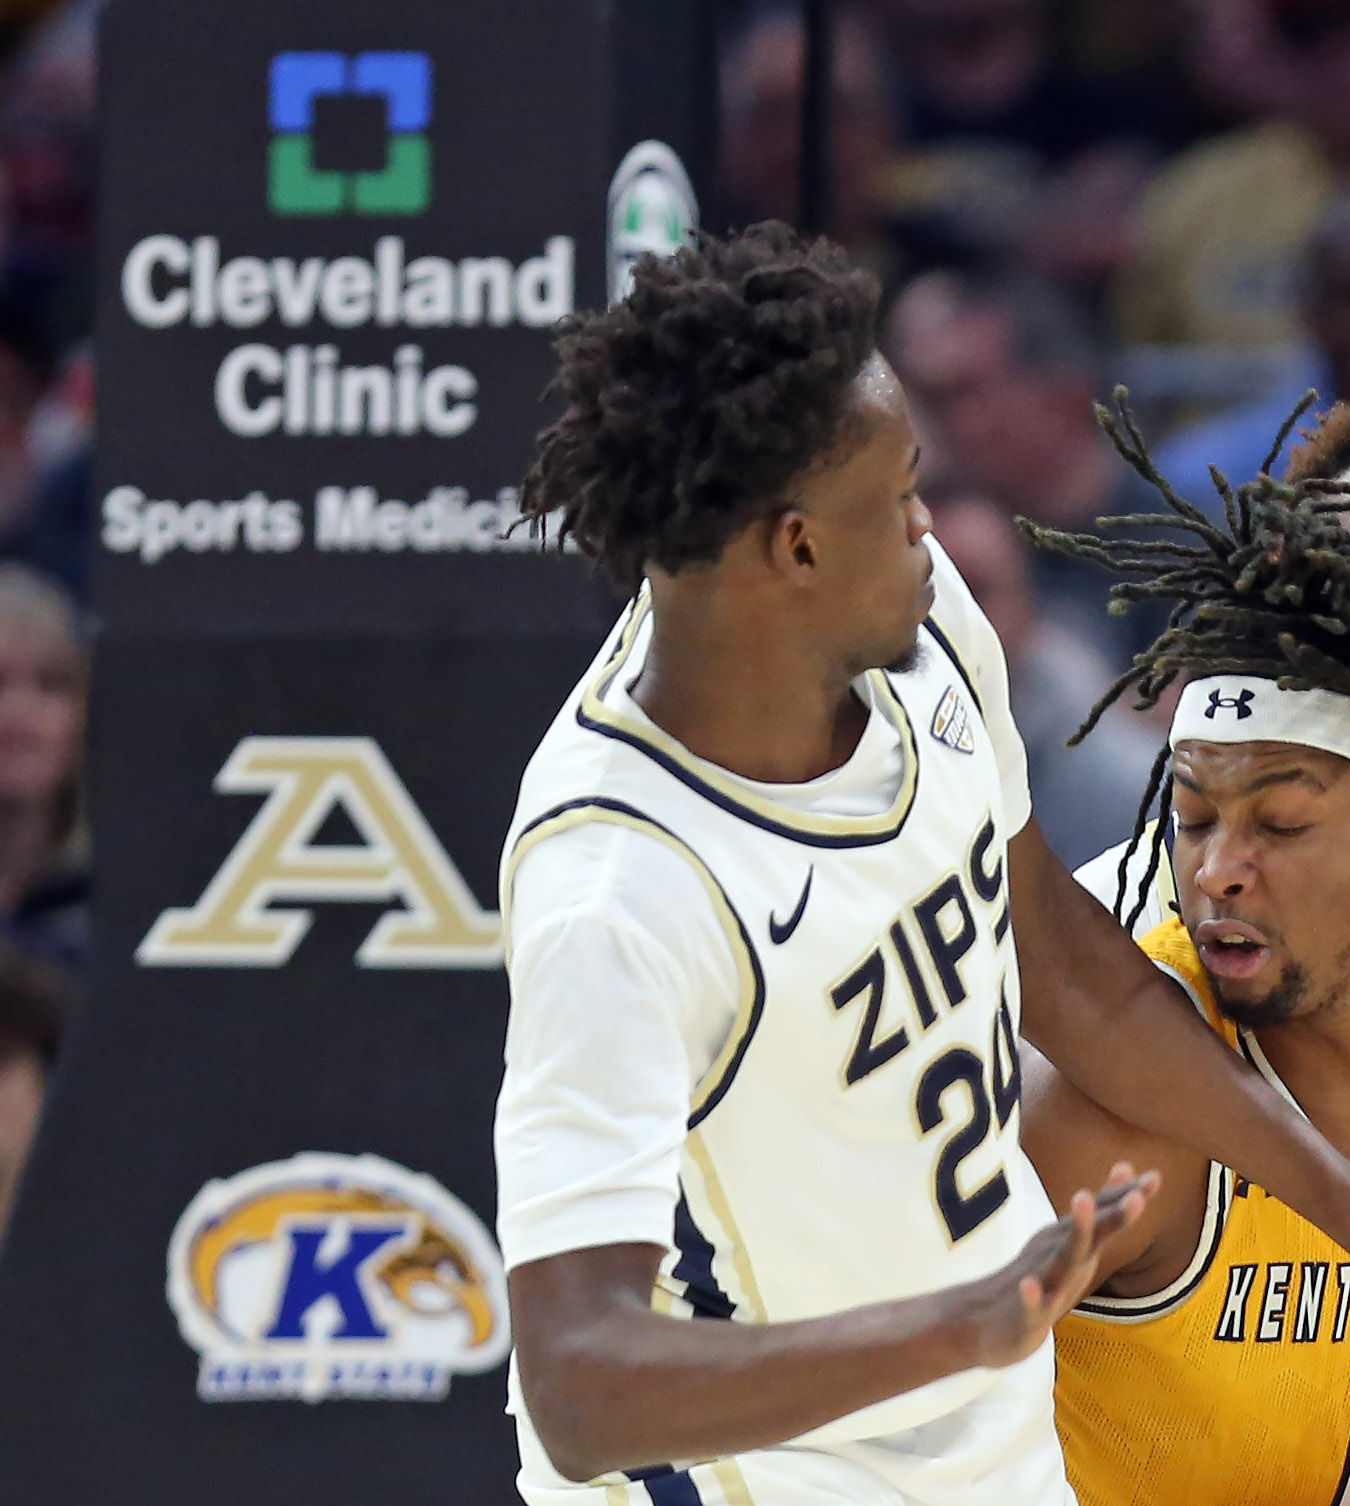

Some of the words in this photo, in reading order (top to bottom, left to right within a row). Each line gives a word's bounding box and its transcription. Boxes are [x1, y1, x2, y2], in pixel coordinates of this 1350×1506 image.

[121, 234, 576, 329] Cleveland
[213, 343, 479, 438] Clinic
[102, 485, 300, 564] Sports
[315, 486, 588, 554] Medicin
[134, 735, 504, 968] A
[915, 972, 1022, 1244] 24
[265, 1222, 409, 1341] K
